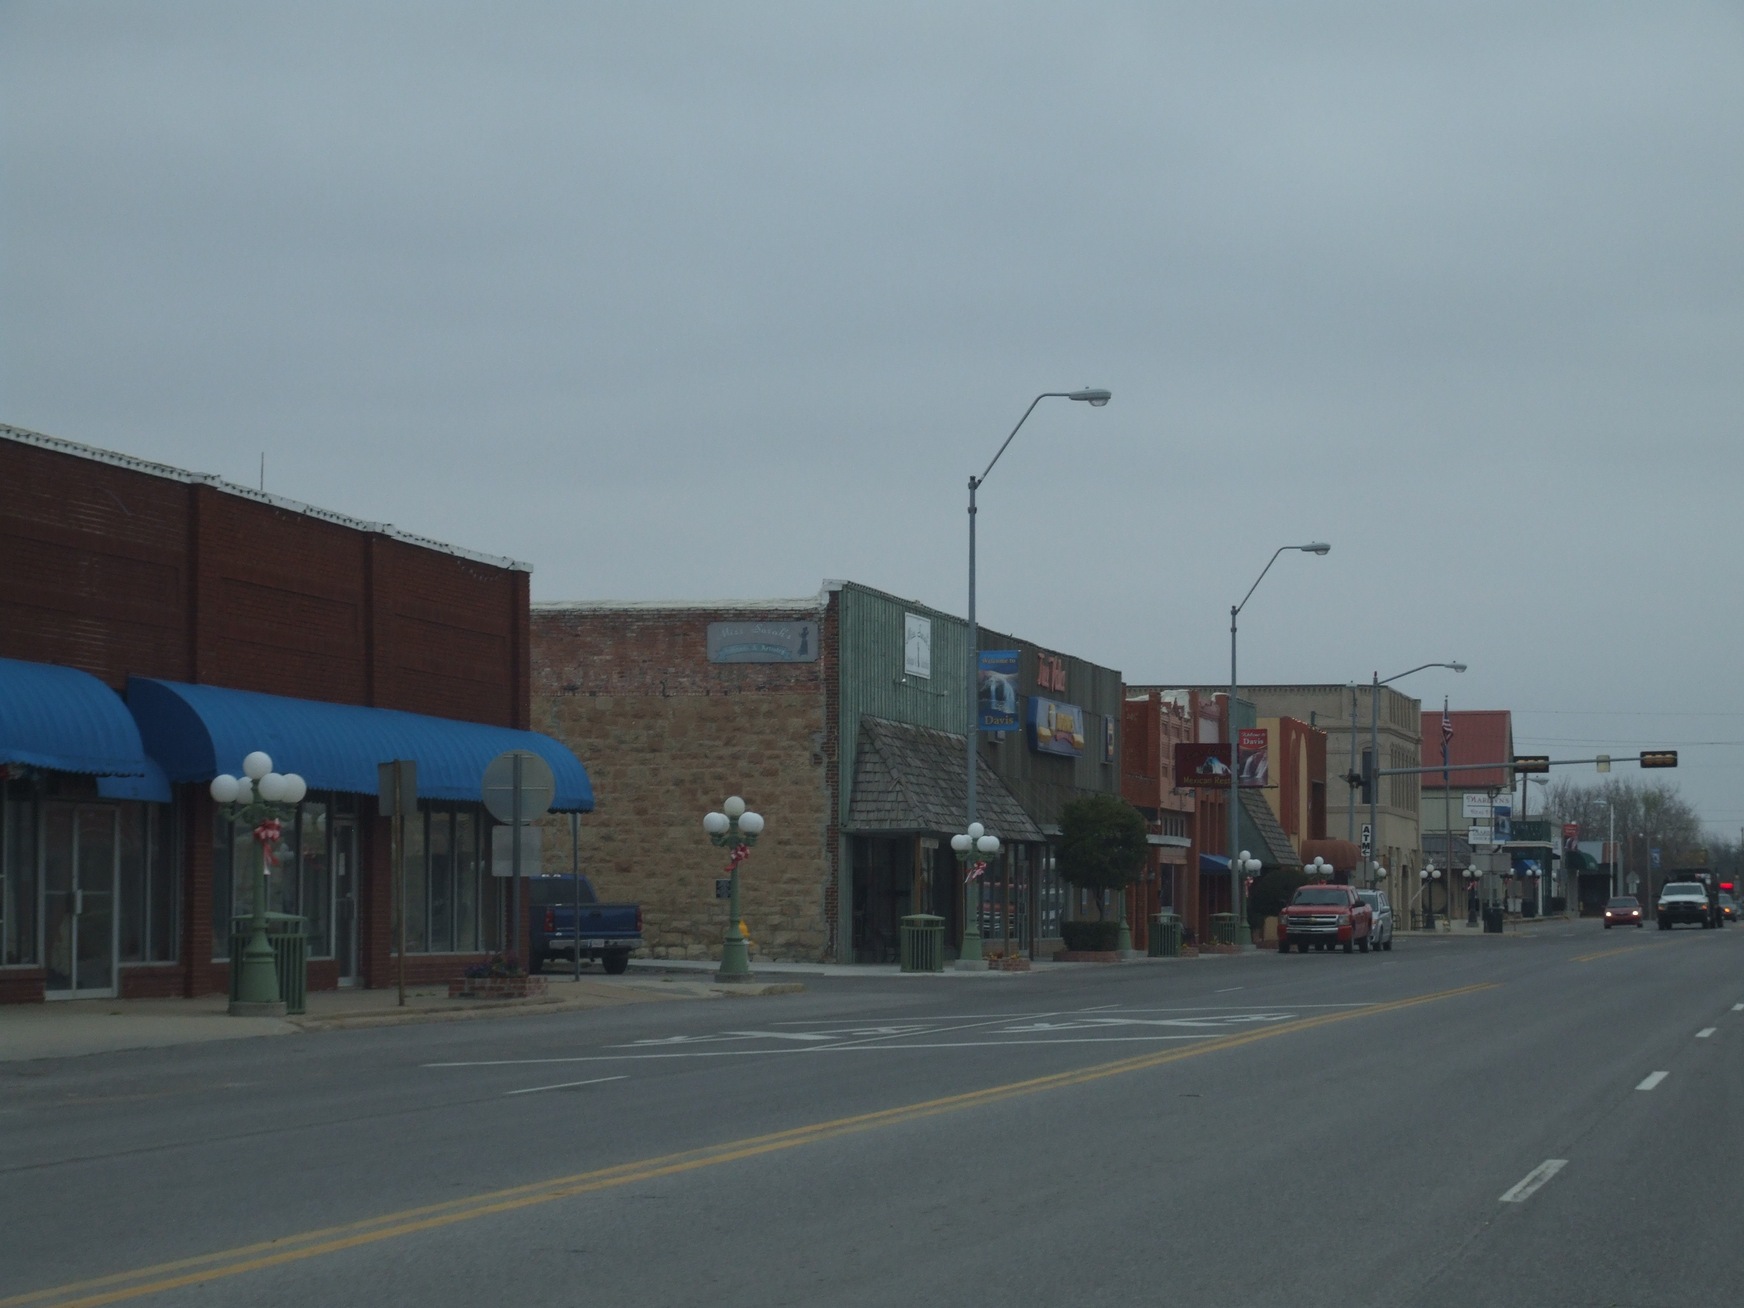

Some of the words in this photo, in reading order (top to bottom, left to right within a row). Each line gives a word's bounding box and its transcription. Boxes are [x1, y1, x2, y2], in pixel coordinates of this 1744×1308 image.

[751, 623, 793, 640] Sarah's
[984, 715, 1015, 725] Davis
[1183, 776, 1212, 784] Mexican
[1362, 825, 1370, 849] ATM
